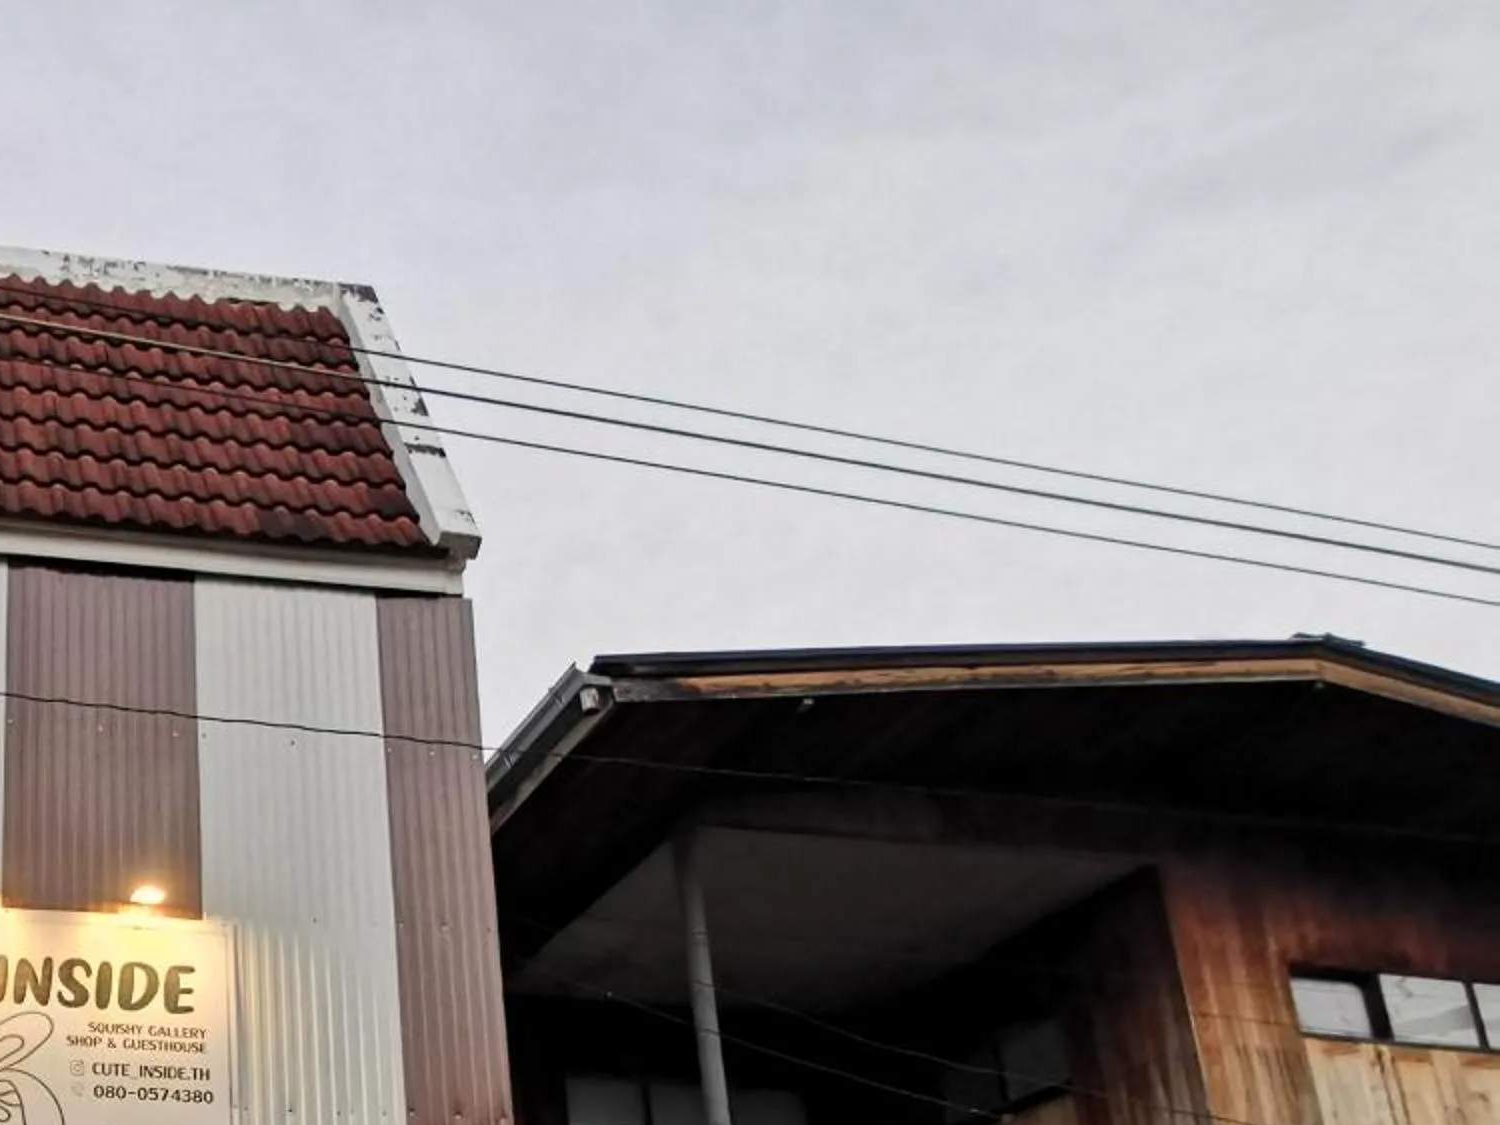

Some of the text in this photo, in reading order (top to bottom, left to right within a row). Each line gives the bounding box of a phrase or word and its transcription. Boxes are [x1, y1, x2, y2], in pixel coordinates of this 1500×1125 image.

[87, 1022, 207, 1039] SQUISHY GALLERY
[66, 1035, 206, 1053] SHOP & GUESTHOUSE
[93, 1085, 214, 1104] 080-0574380
